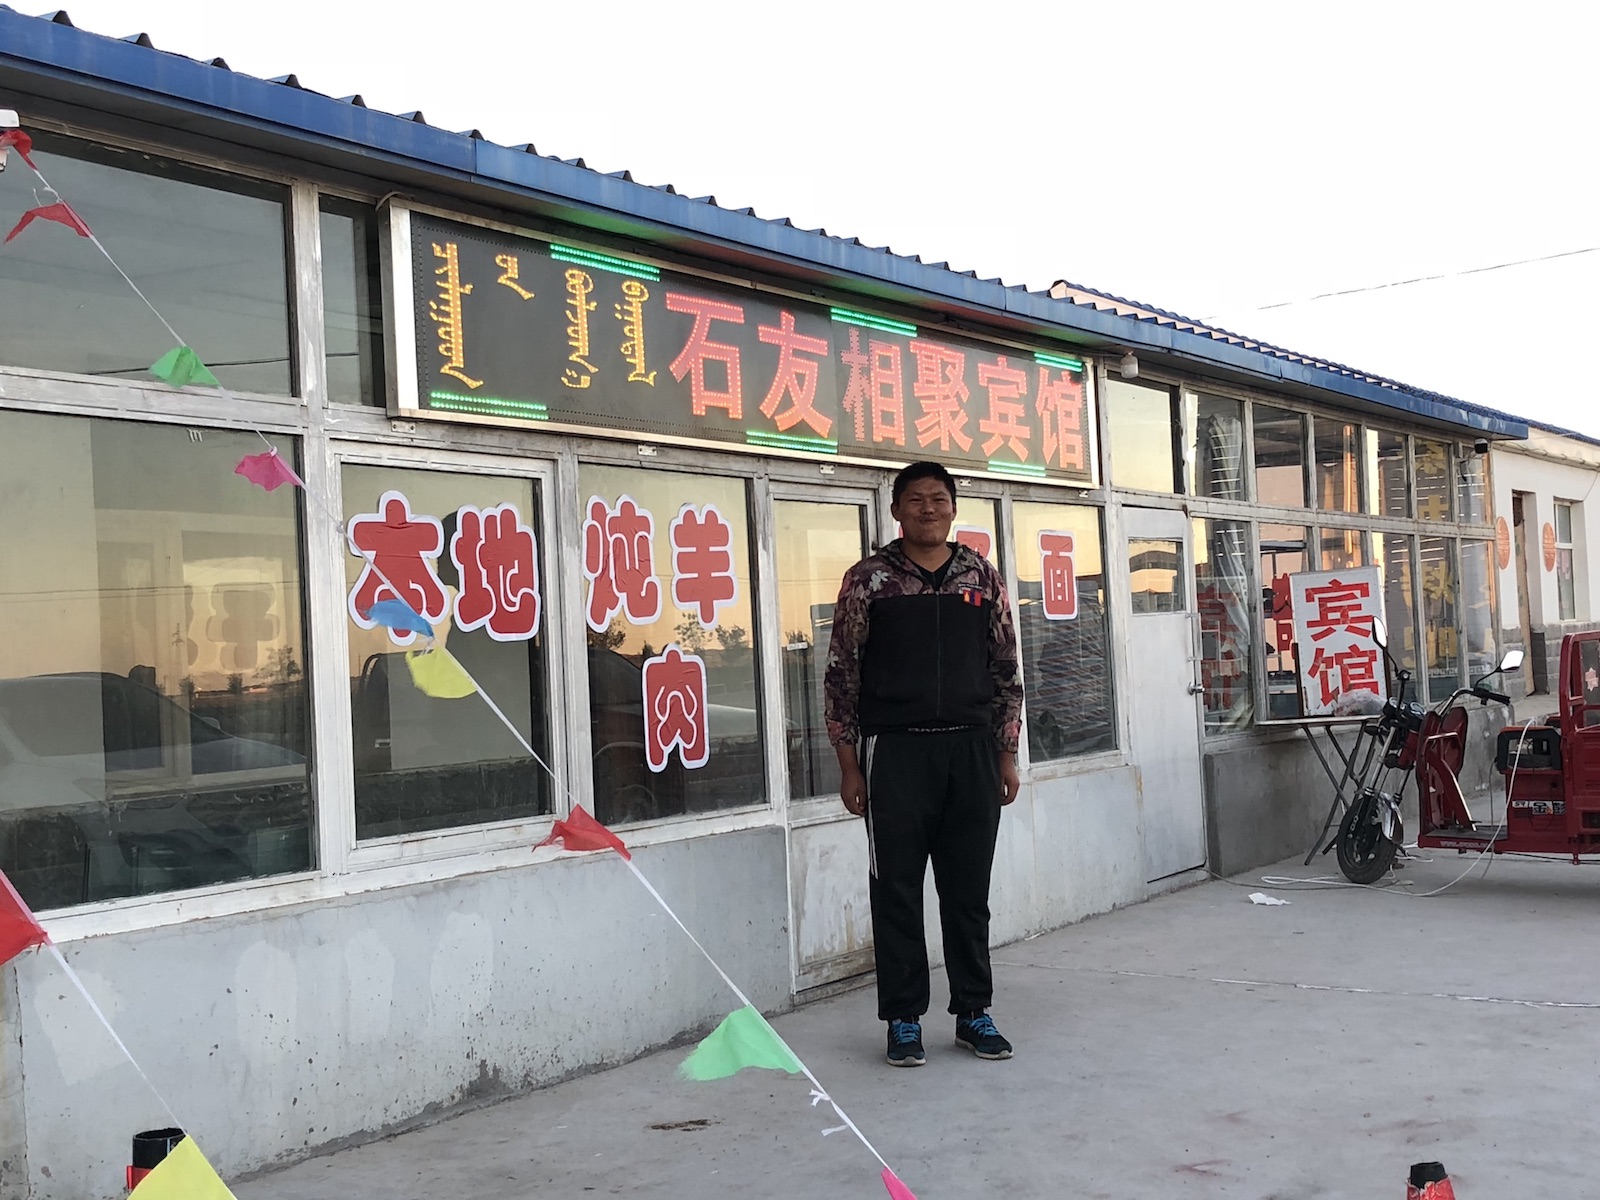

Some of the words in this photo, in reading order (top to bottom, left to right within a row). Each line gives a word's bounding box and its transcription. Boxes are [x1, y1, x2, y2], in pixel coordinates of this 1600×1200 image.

[665, 293, 1085, 471] 石友相聚宾馆
[1304, 577, 1380, 707] 宾馆
